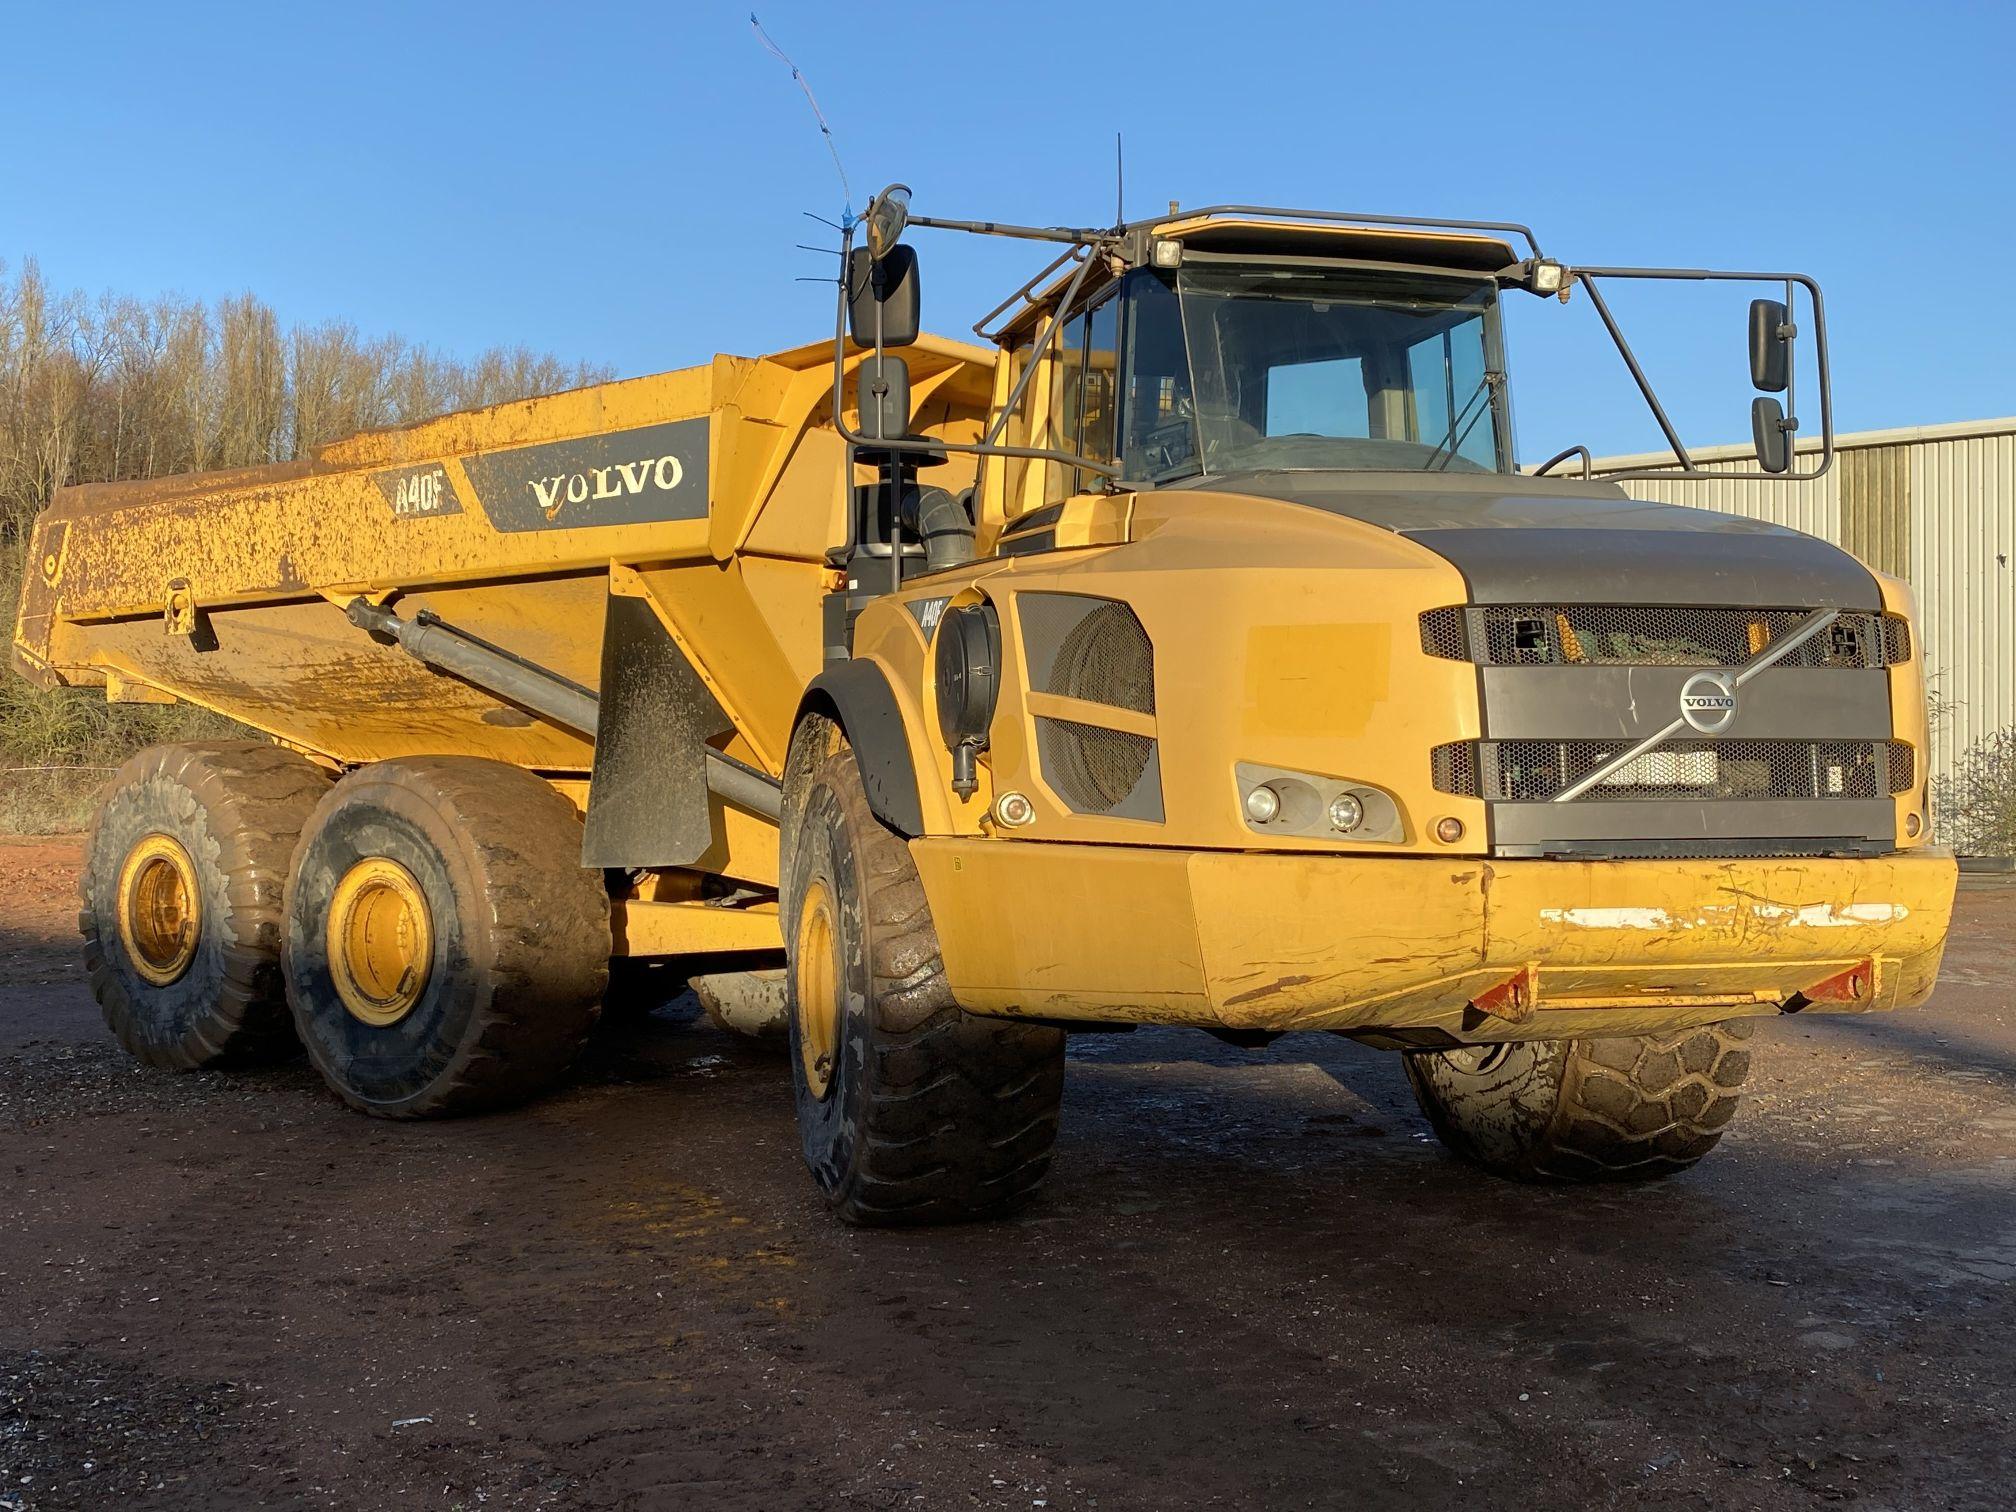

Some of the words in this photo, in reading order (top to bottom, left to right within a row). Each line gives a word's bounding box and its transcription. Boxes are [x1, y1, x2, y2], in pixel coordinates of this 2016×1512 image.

[395, 469, 443, 514] A40F
[528, 455, 683, 508] VOLVO
[921, 600, 943, 628] A40F
[1683, 698, 1734, 707] VOLVO
